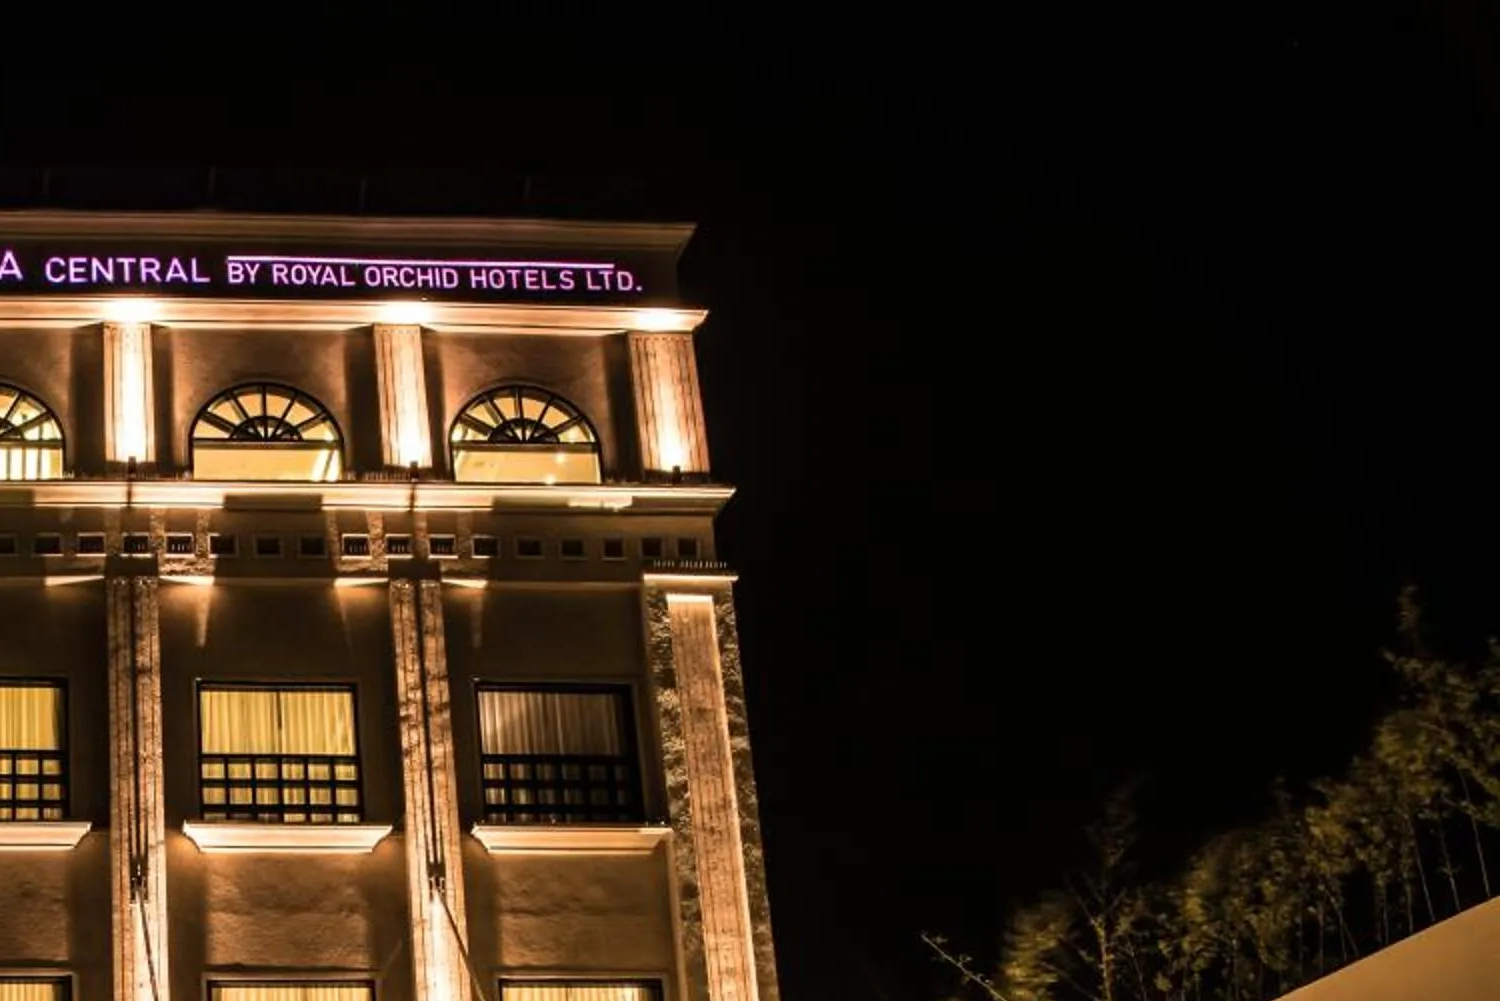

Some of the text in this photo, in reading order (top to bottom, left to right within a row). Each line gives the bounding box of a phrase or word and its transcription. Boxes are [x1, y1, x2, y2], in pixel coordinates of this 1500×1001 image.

[45, 255, 211, 284] CENTRAL
[227, 263, 260, 284] BY
[271, 263, 356, 288] ROYAL
[364, 266, 459, 290] ORCHID
[469, 267, 575, 291] HOTELS
[586, 269, 644, 292] LTD.
